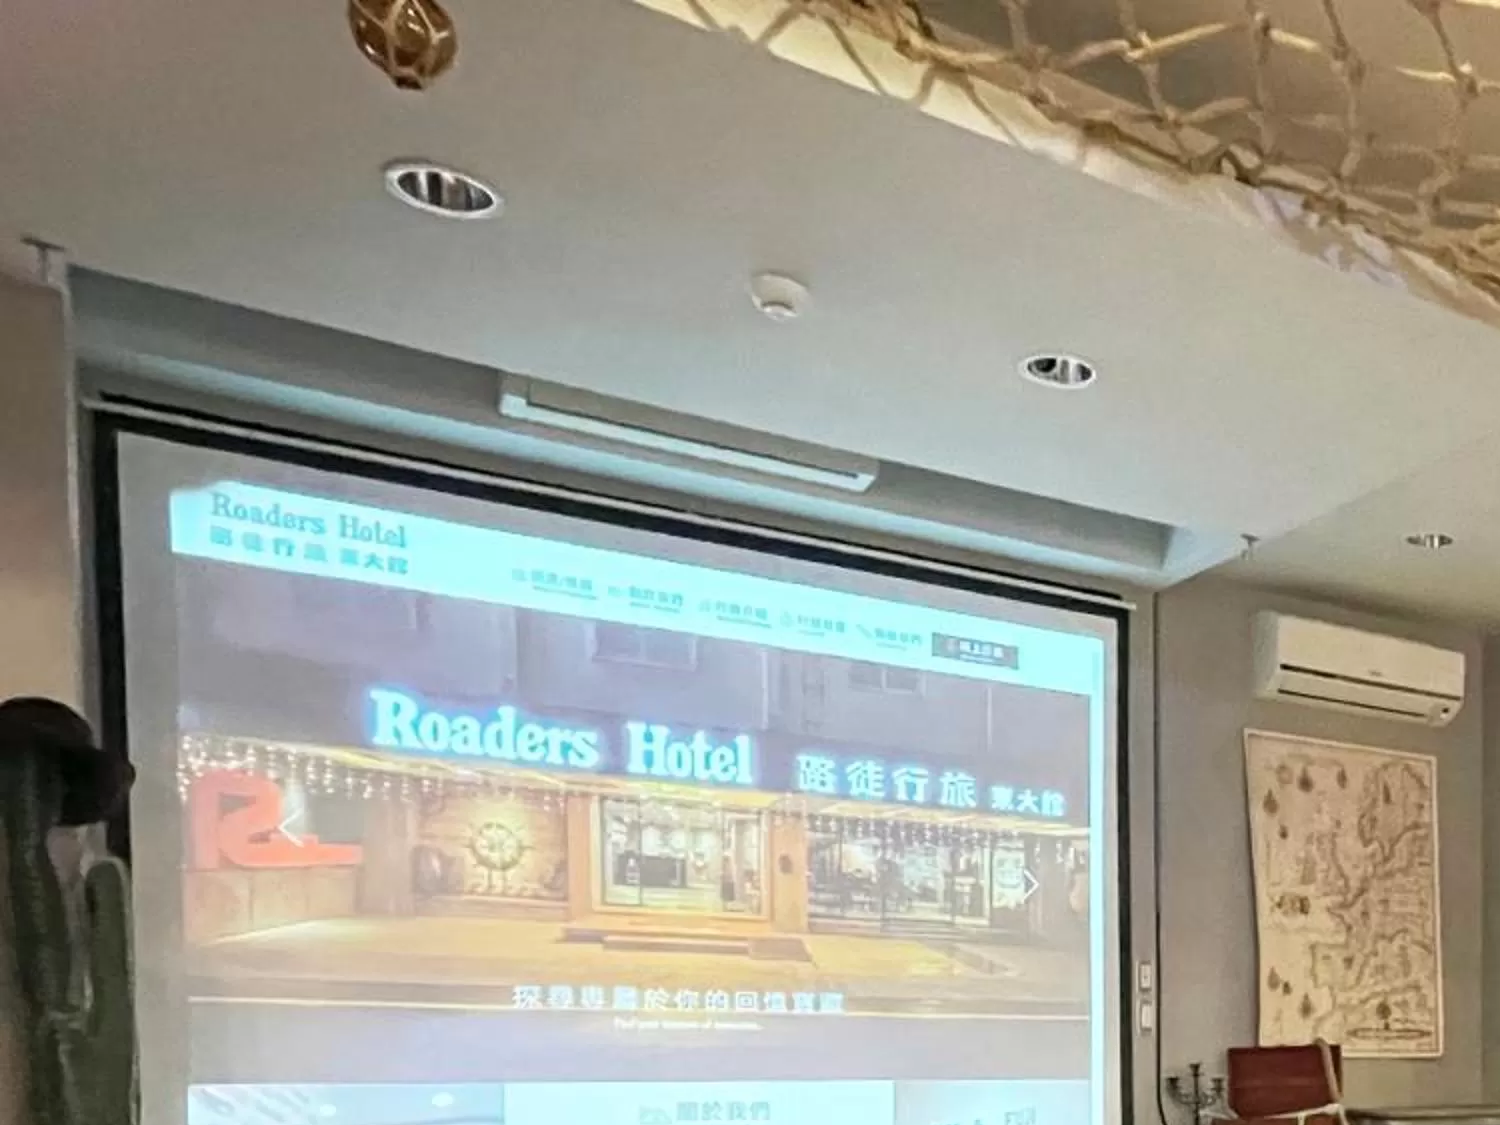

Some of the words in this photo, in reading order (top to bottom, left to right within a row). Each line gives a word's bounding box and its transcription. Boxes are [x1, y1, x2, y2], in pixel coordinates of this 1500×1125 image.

[211, 491, 327, 534] Roaders
[339, 513, 407, 549] Hotel
[368, 687, 600, 769] Roaders
[625, 720, 753, 784] Hotel
